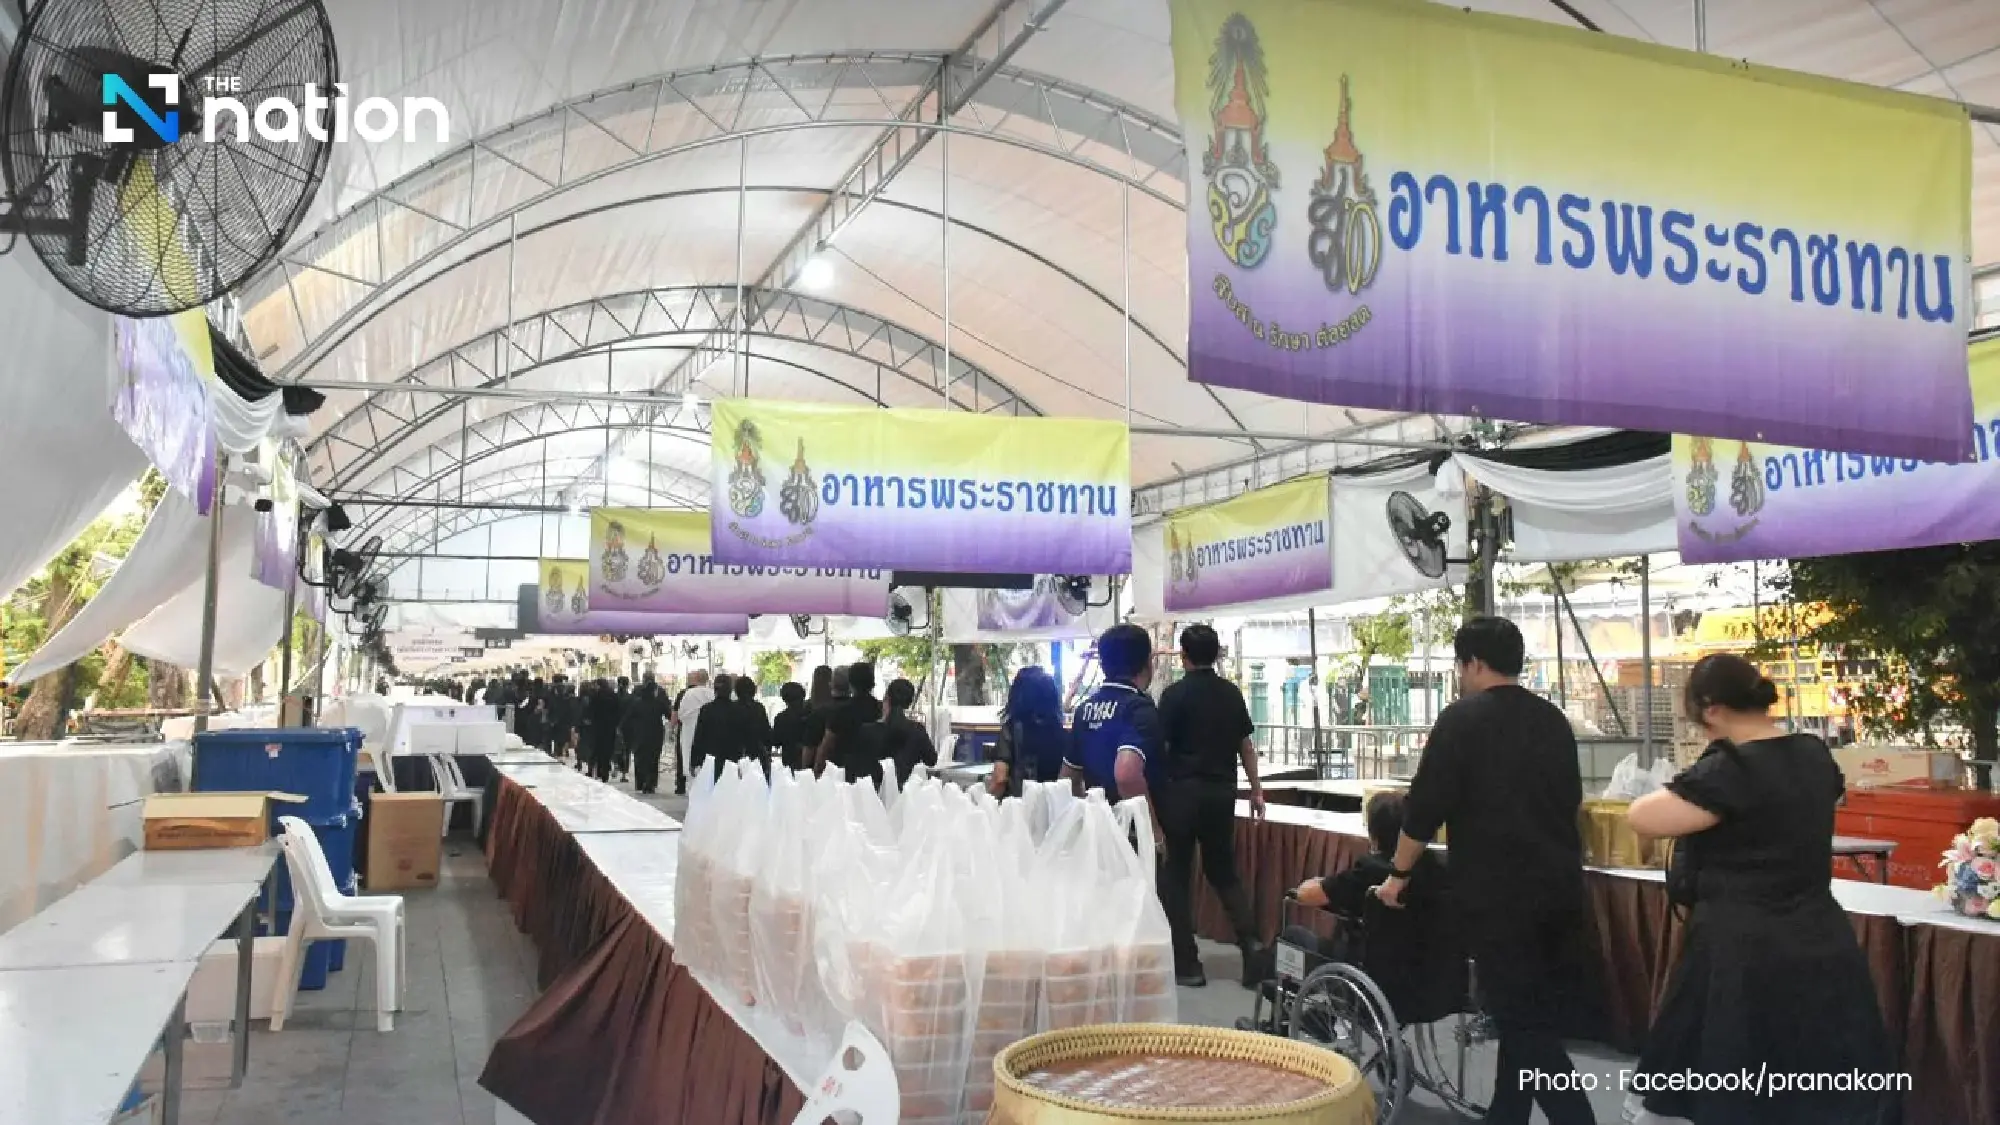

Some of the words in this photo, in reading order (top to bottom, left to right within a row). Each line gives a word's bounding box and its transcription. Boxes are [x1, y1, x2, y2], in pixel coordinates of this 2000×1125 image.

[1388, 170, 1955, 323] อาหารพระราชทาน
[822, 473, 1117, 517] อาหารพระราชทาน
[1196, 519, 1325, 569] อาหารพระราชทาน
[1082, 700, 1119, 721] กทม
